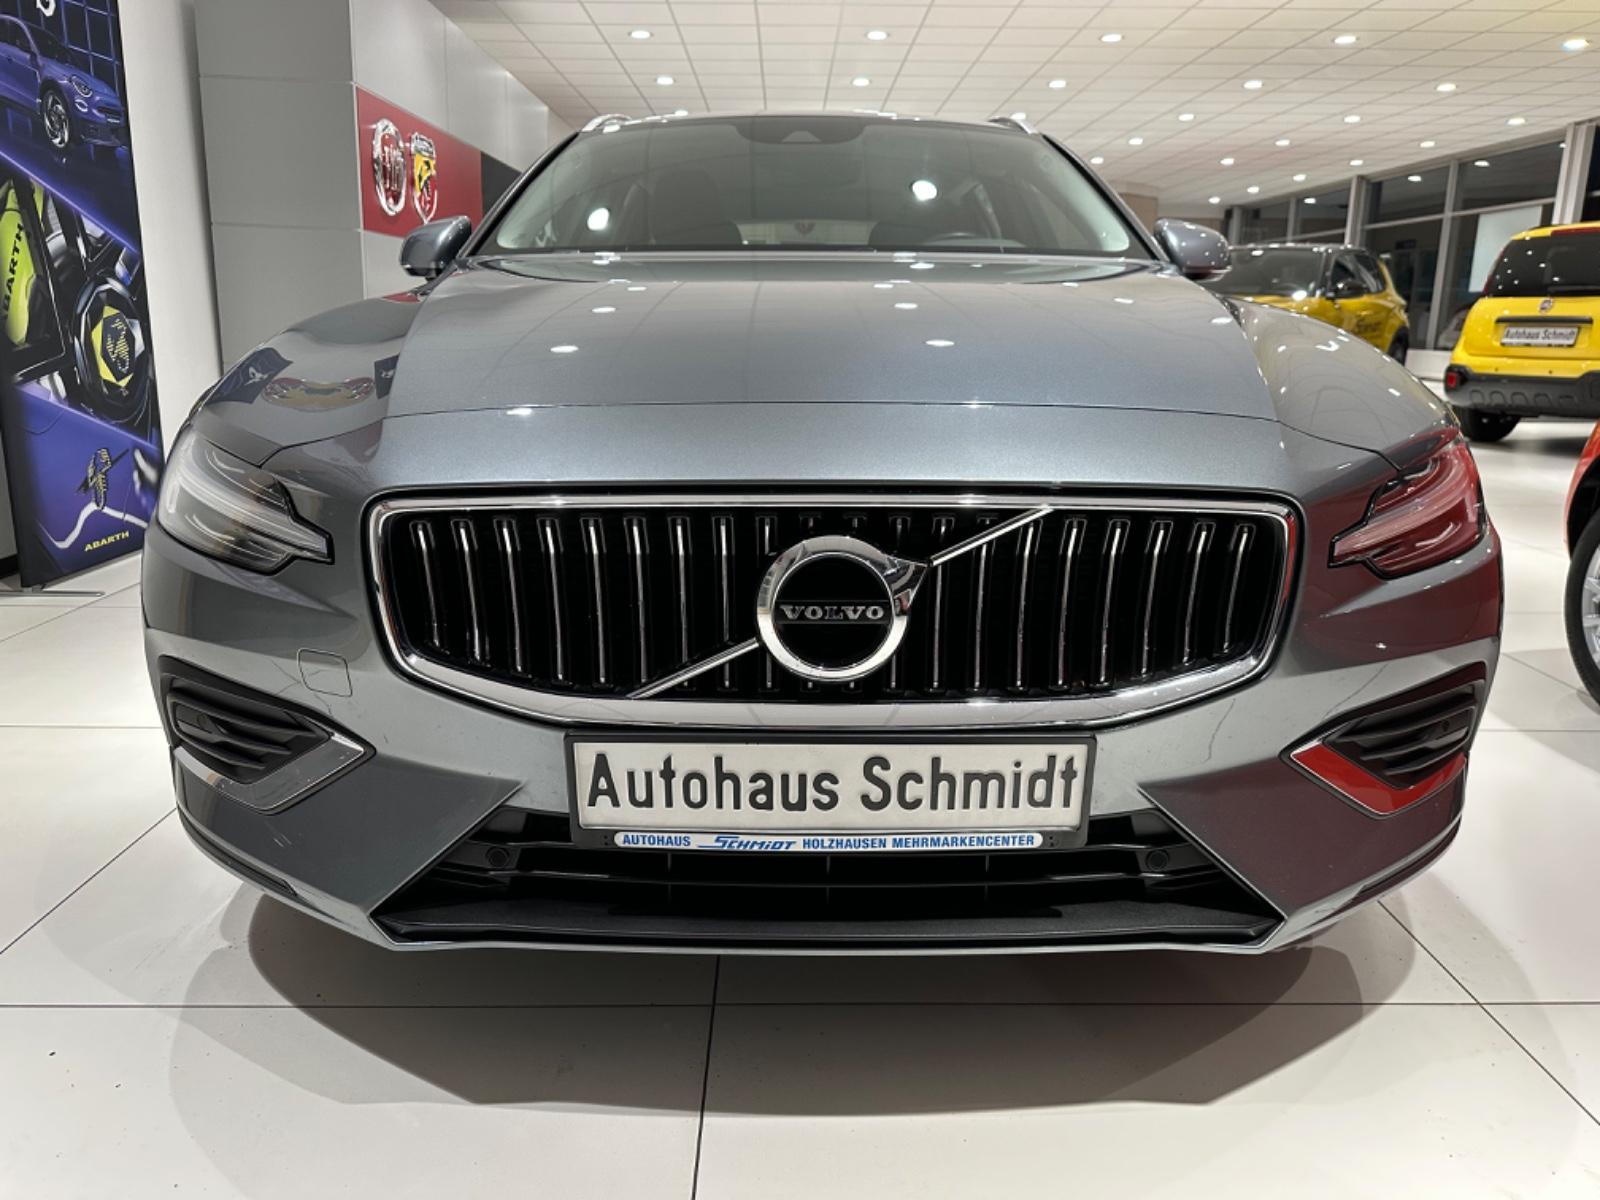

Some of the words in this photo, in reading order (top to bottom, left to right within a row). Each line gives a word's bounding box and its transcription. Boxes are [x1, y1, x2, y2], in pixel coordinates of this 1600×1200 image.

[84, 531, 129, 551] ABARTH
[779, 605, 885, 620] VOLVO
[586, 753, 840, 811] Autohaus
[859, 754, 1078, 810] Schmidt
[622, 834, 691, 847] AUTOHAUS
[802, 836, 888, 849] HOLZHAUSEN
[891, 834, 1035, 849] MEHRMARKENCENTER
